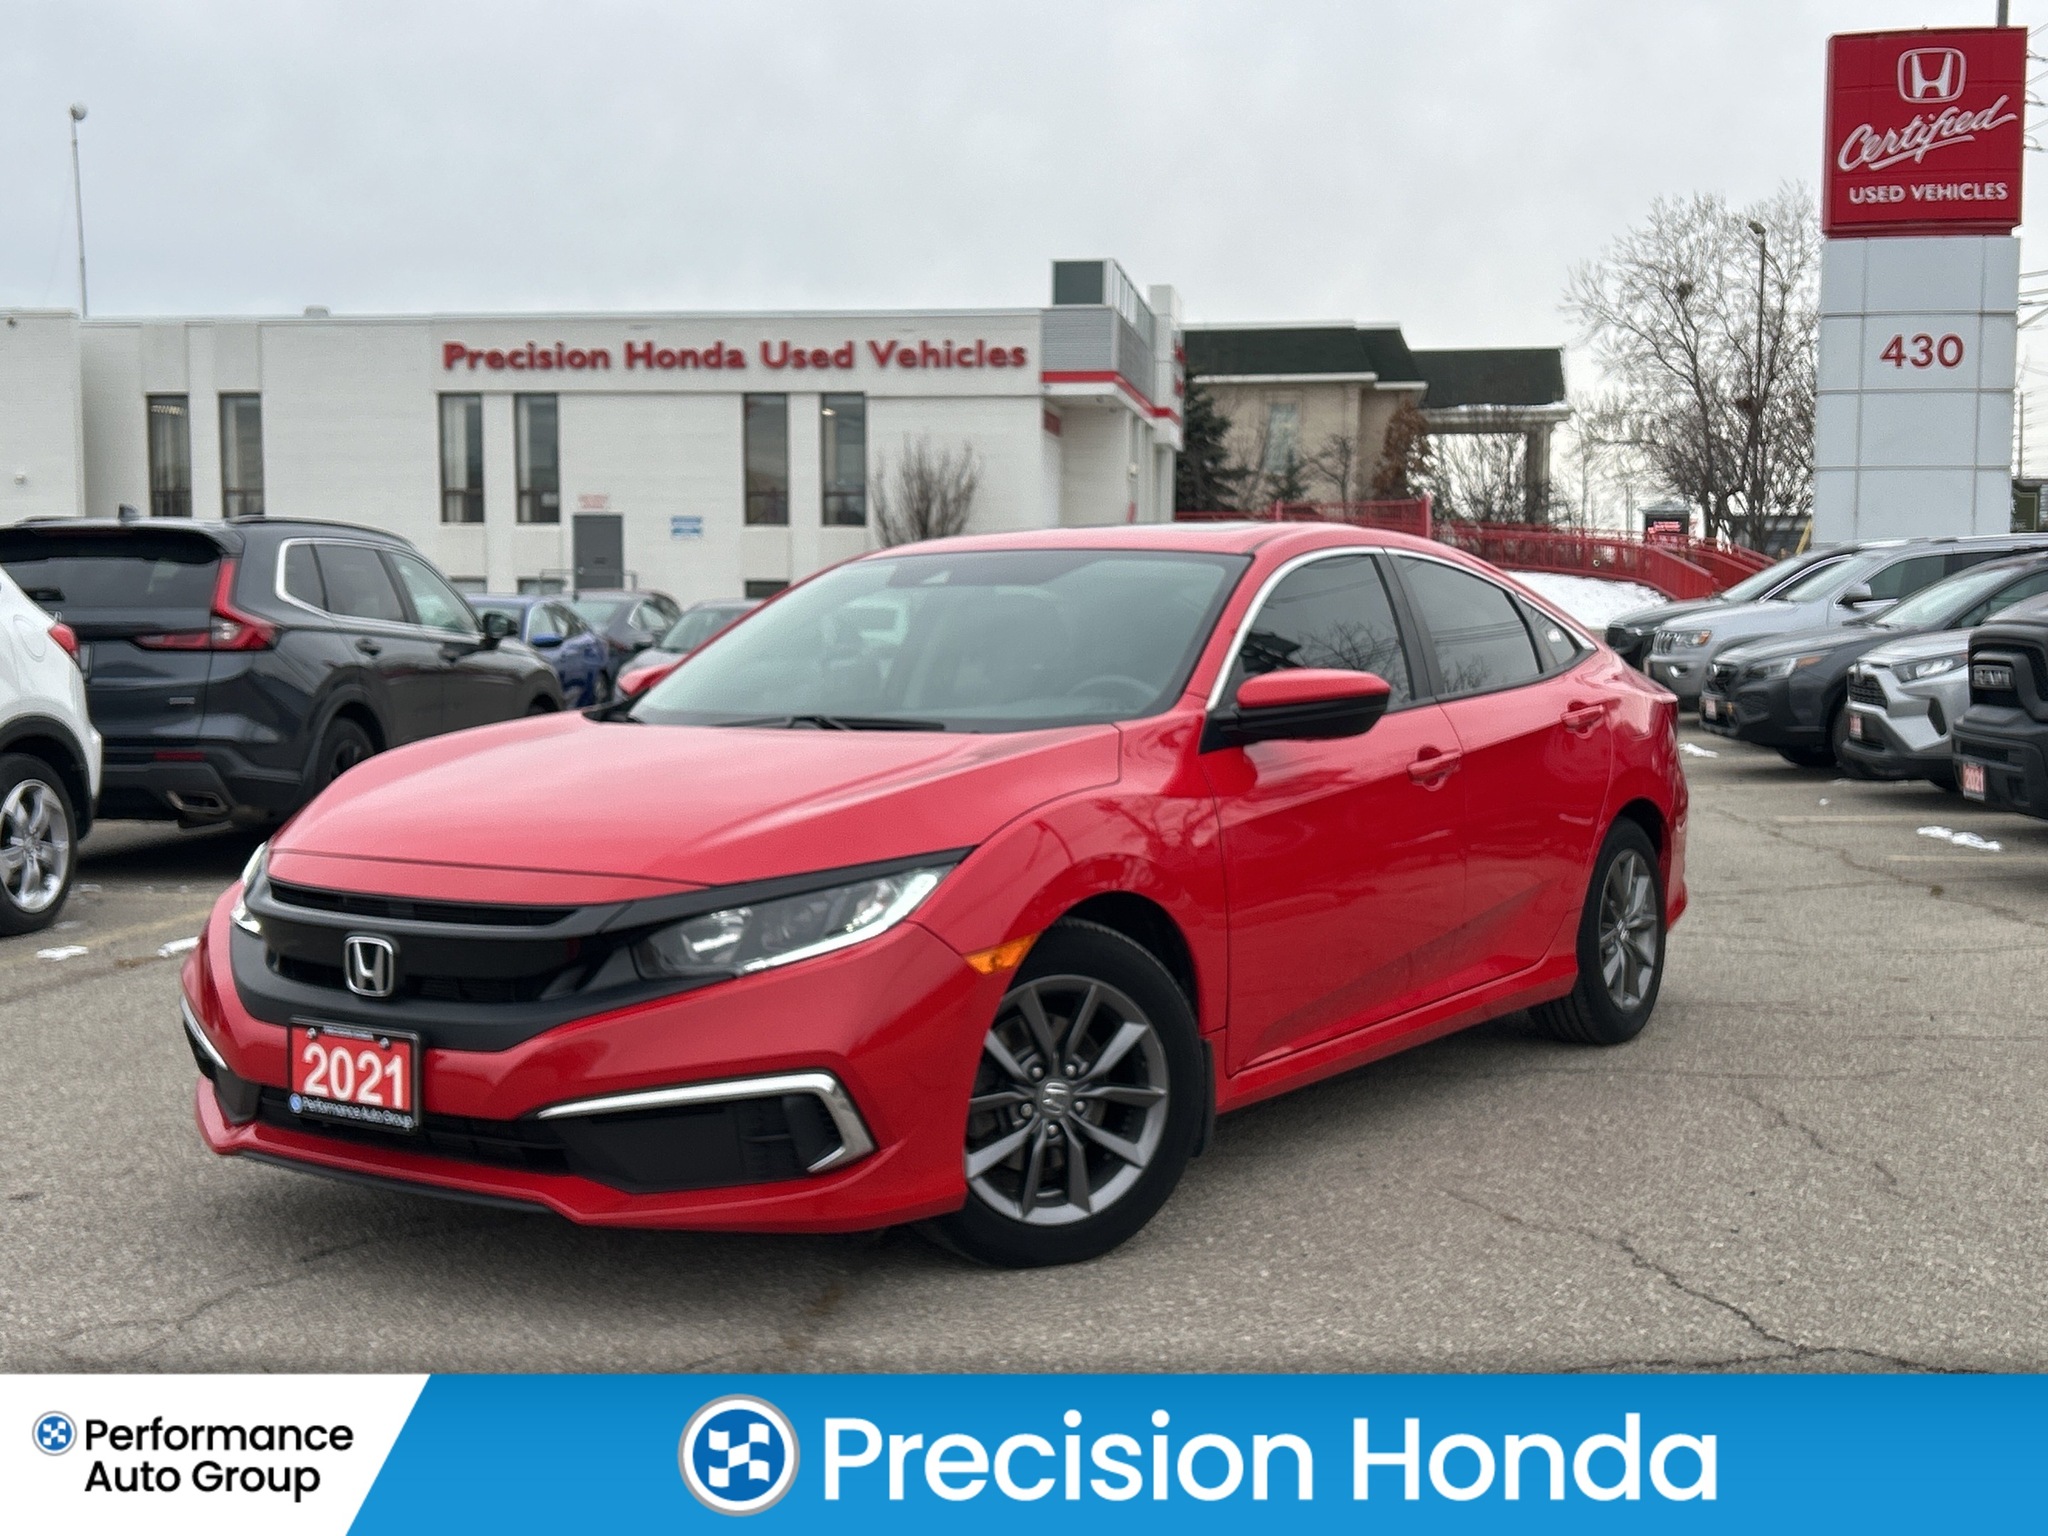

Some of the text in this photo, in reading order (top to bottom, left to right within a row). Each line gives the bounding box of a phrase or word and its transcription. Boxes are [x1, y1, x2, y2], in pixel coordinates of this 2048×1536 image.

[1838, 94, 2018, 171] Certified
[1848, 182, 2009, 204] USED VEHICLES
[443, 339, 1027, 370] Precision Honda Used Vehicles
[1880, 333, 1965, 369] 430
[302, 1042, 404, 1109] 2021
[302, 1096, 414, 1132] Performance Auto Group
